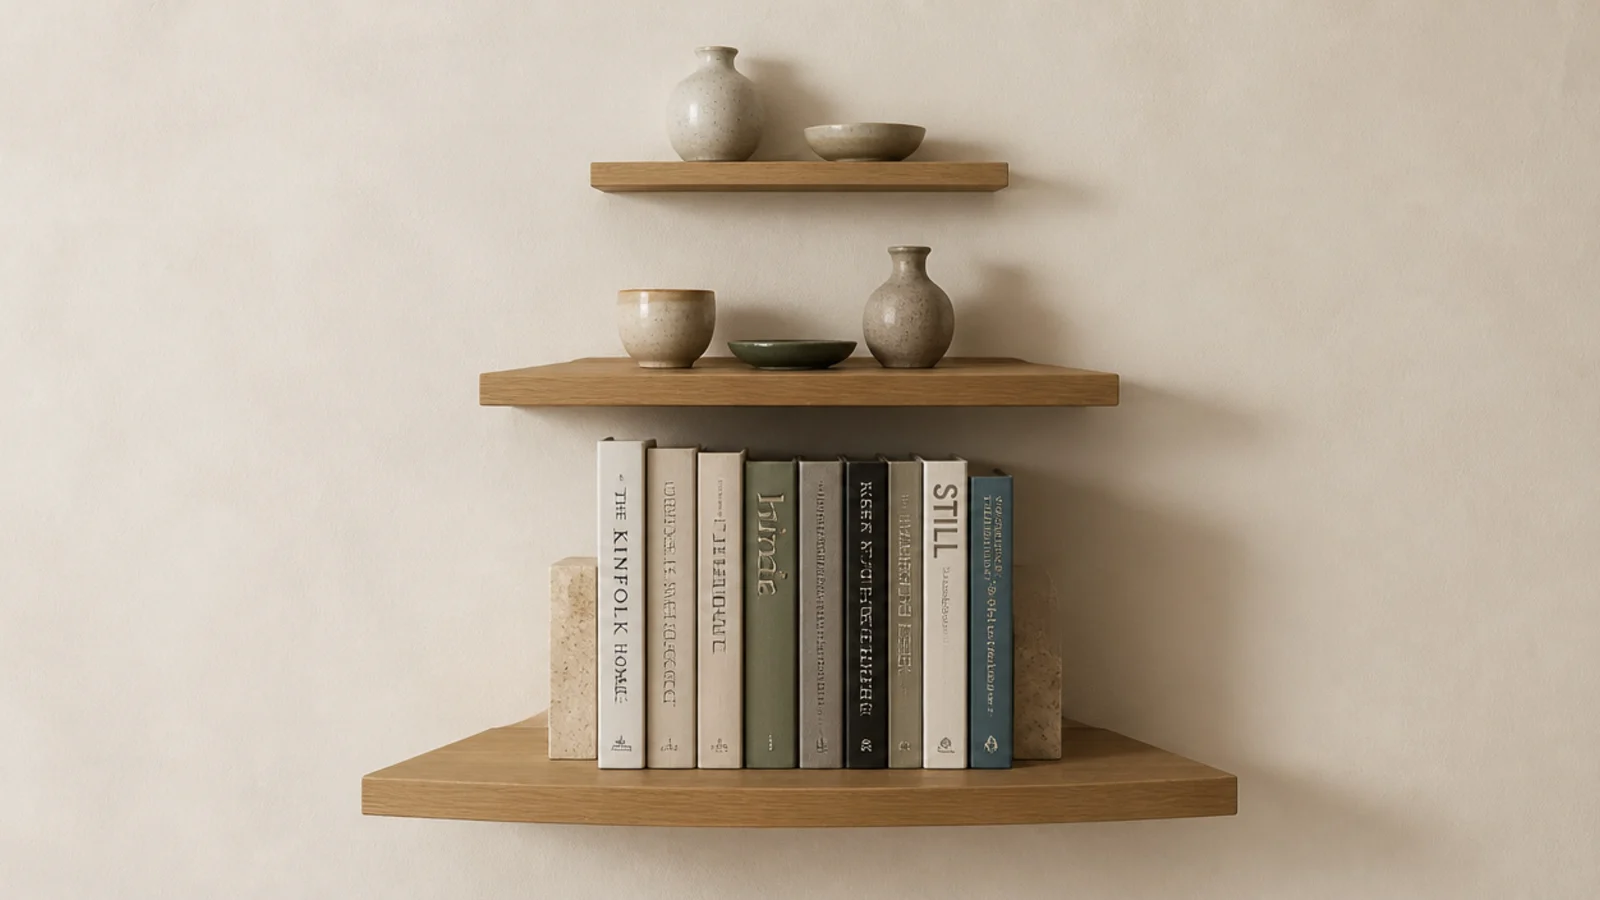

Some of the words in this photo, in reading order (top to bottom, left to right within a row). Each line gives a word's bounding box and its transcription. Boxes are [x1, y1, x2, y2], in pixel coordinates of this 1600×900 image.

[614, 487, 627, 521] THE
[933, 484, 958, 559] STILL
[613, 528, 629, 635] KINFOLK
